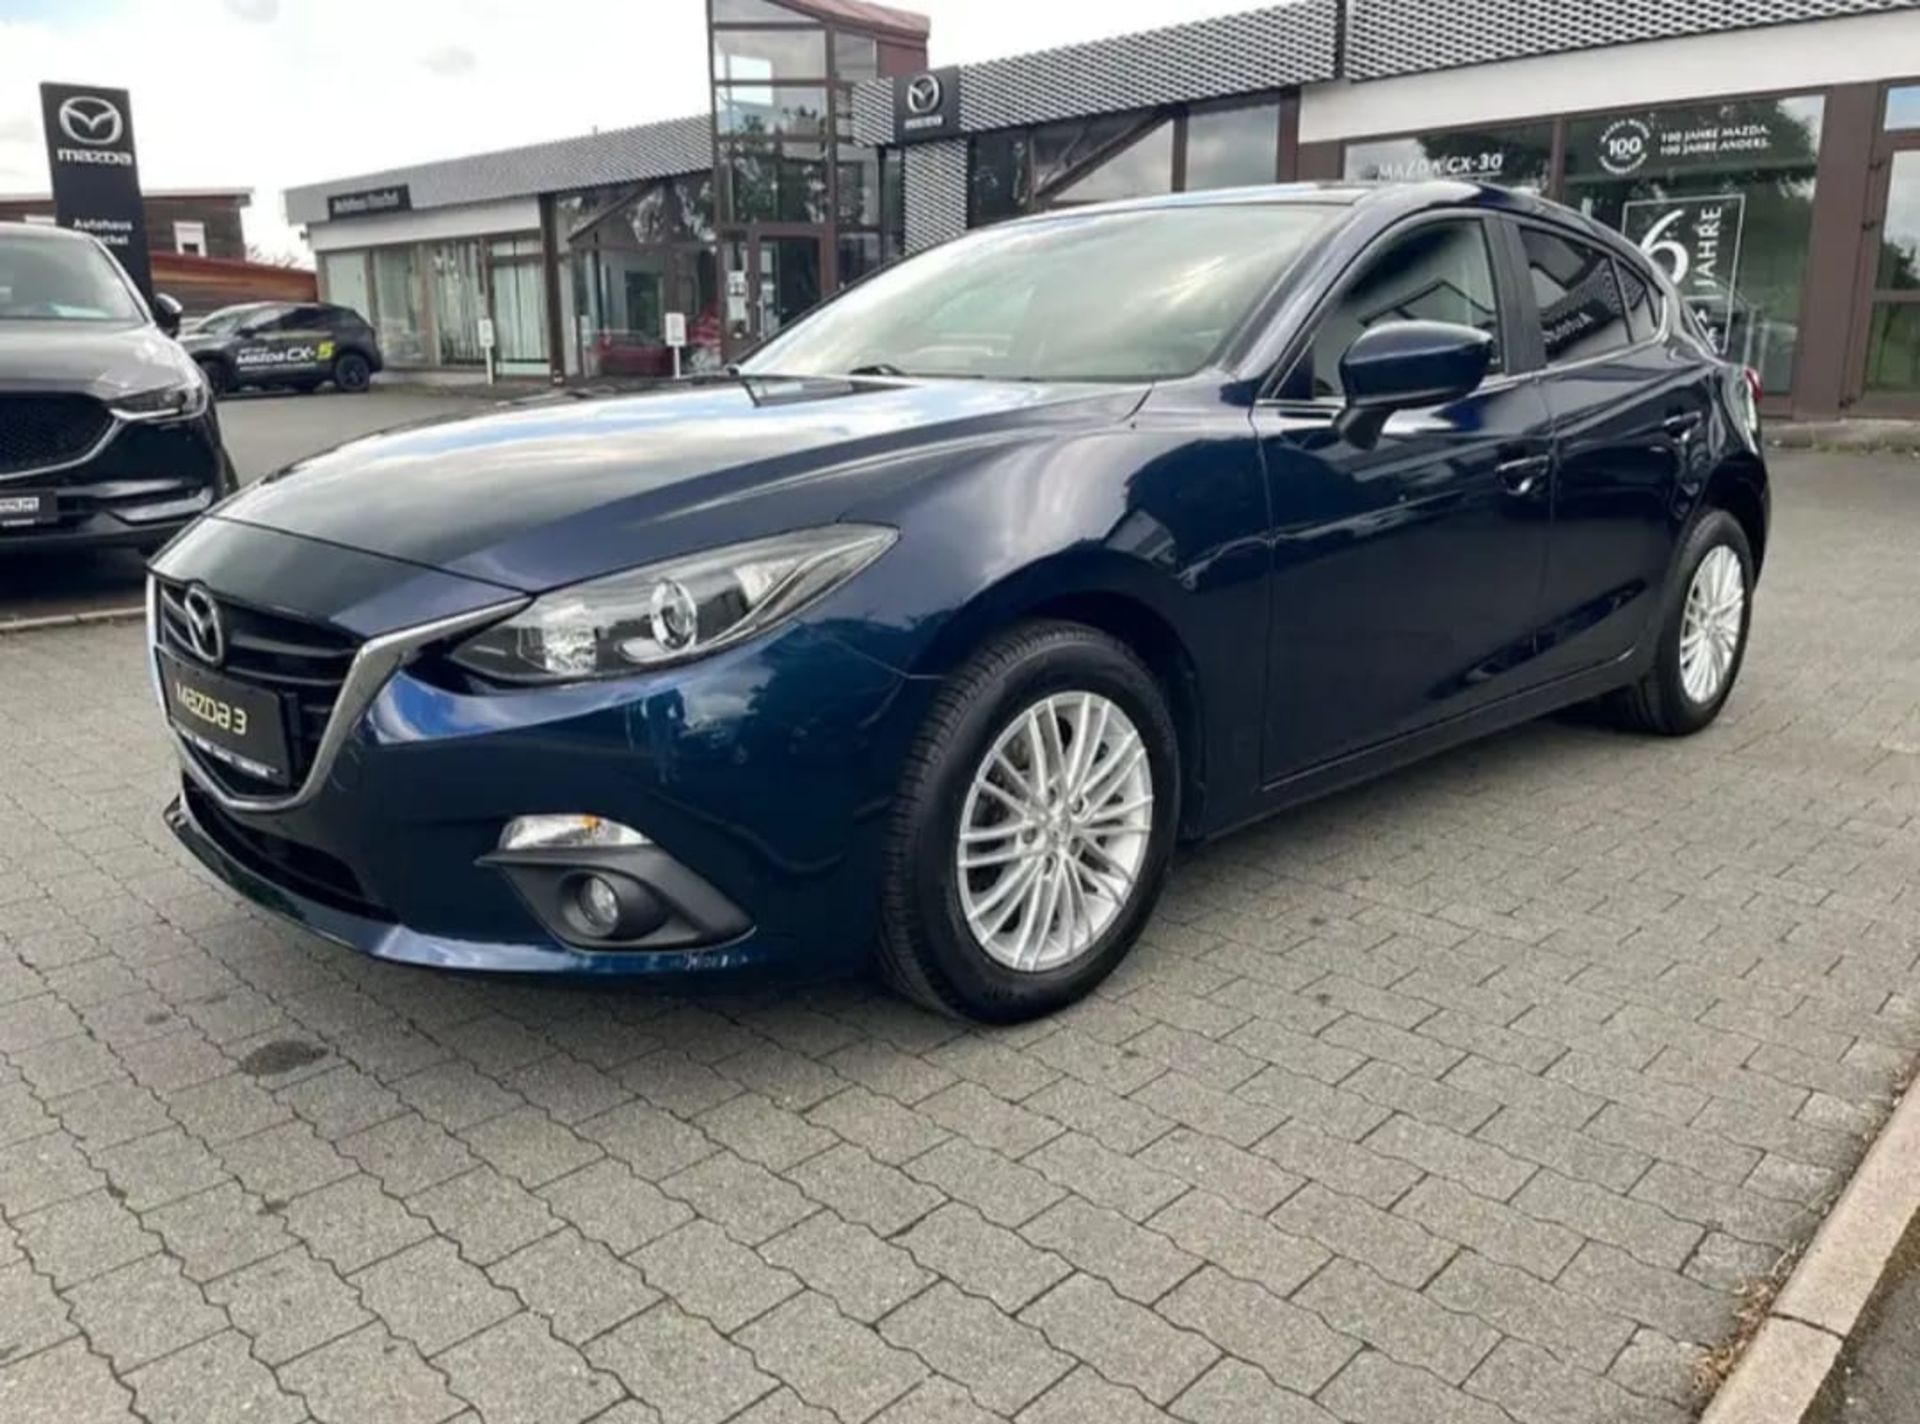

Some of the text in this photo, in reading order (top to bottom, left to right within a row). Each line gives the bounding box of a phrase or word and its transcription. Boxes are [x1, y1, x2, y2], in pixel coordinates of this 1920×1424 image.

[1610, 136, 1641, 156] 100
[1446, 153, 1502, 173] CX-30
[73, 218, 132, 231] Autohaus
[1694, 207, 1721, 288] JAHRE
[232, 707, 248, 735] 3
